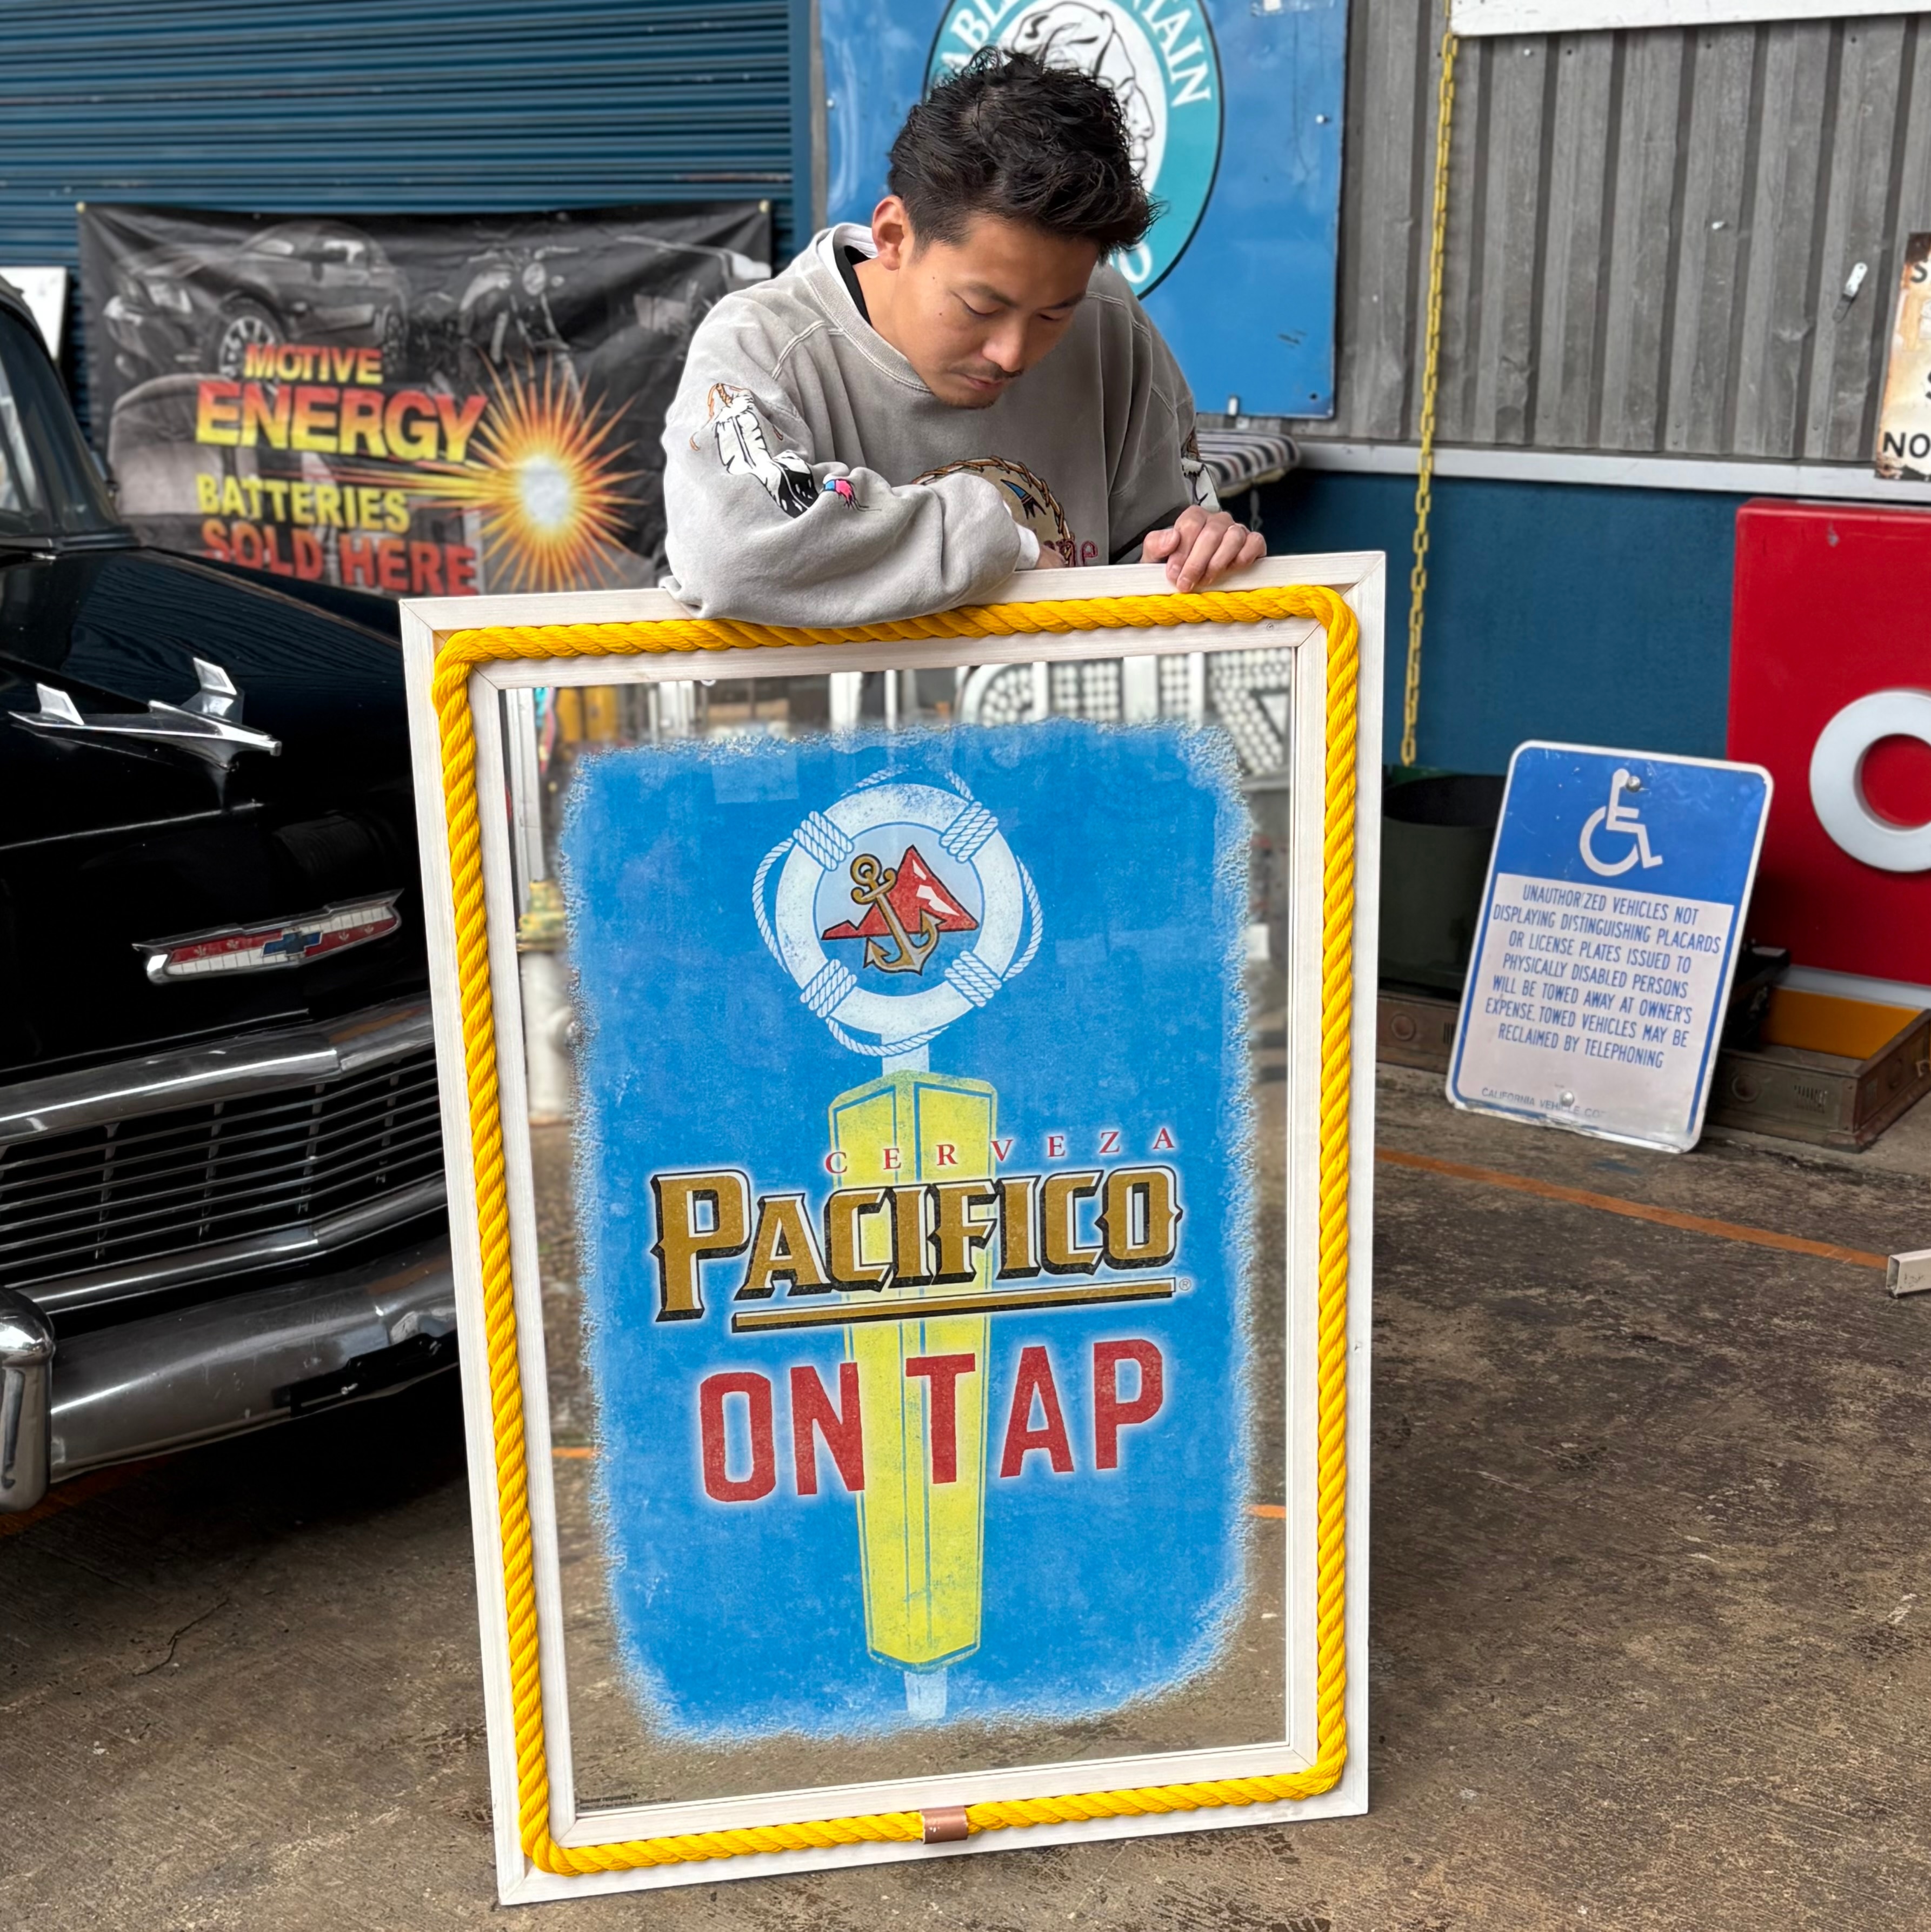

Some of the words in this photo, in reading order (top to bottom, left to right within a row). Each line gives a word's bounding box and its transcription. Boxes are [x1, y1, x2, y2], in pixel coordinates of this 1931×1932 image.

[244, 344, 383, 384] MOTIVE
[196, 381, 487, 462] ENERGY
[196, 474, 410, 534] BATTERIES
[202, 519, 323, 580] SOLD
[339, 533, 479, 596] HERE
[1493, 904, 1556, 928] DISPLAYING
[1561, 913, 1651, 943] DISTINGUISHING
[1656, 928, 1721, 954] PLACARDS
[1613, 897, 1669, 920] VEHICLES
[1674, 906, 1699, 925] NOT
[1503, 953, 1568, 978] PHYSICALLY
[1571, 964, 1627, 988] DISABLED
[1632, 974, 1688, 999] PERSONS
[1509, 930, 1524, 948] OR
[1529, 933, 1575, 955] LICENSE
[1579, 941, 1621, 962] PLATES
[1627, 947, 1670, 970] ISSUED
[1677, 955, 1692, 974] TO
[1485, 997, 1535, 1022] EXPENSE.
[1539, 1006, 1576, 1028] TOWED
[1582, 1013, 1637, 1039] VEHICLES
[1642, 1024, 1668, 1044] MAY
[1672, 1029, 1689, 1048] BE
[1493, 974, 1516, 994] WILL
[1522, 979, 1537, 998] BE
[1542, 983, 1579, 1004] TOWED
[1583, 990, 1616, 1011] AWAY
[1619, 996, 1635, 1014] AT
[1639, 999, 1693, 1024] OWNER'S
[1498, 1023, 1559, 1049] RECLAIMED
[1563, 1035, 1580, 1053] BY
[1584, 1038, 1664, 1068] TELEPHONING
[1482, 1087, 1535, 1106] CALIFORNIA
[825, 1127, 1175, 1174] CERVEZA
[700, 1362, 865, 1502] ON
[905, 1338, 1163, 1485] TAP
